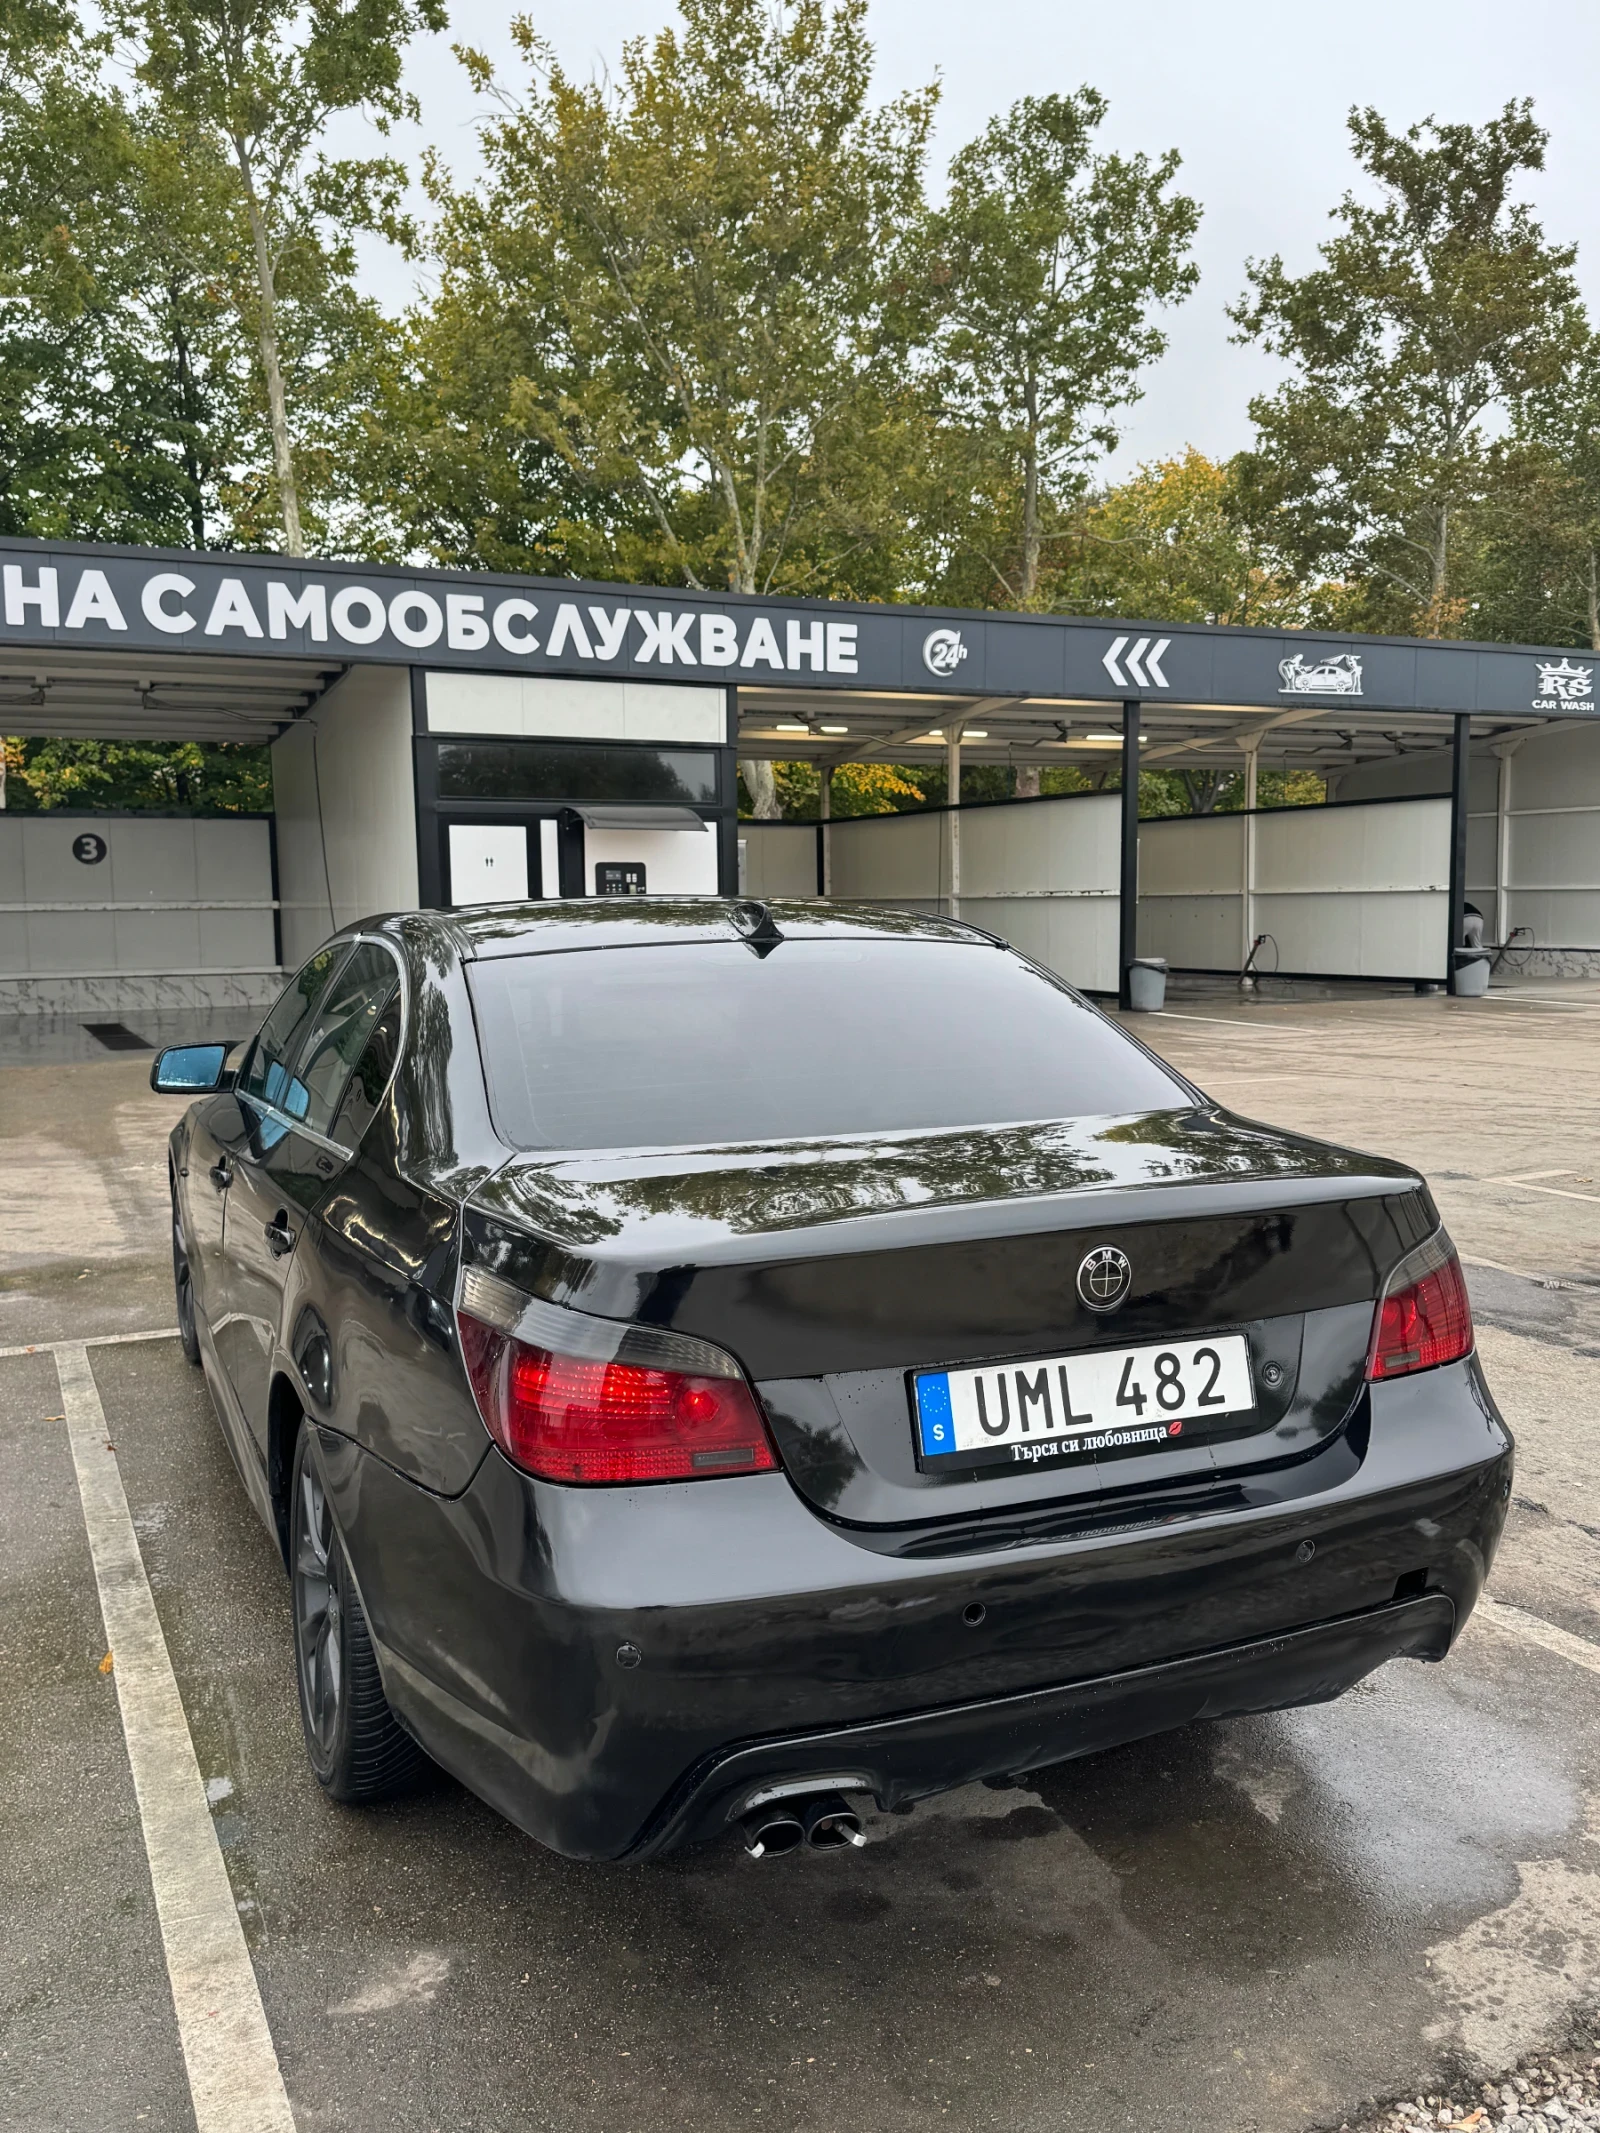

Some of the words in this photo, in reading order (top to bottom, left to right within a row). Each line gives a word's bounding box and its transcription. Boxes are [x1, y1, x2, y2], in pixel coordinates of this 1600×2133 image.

[3, 564, 128, 631] НА
[141, 573, 858, 674] САМООБСЛУЖВАНЕ
[932, 642, 968, 668] 24h
[1538, 675, 1594, 700] RS
[1531, 699, 1557, 709] CAR
[1560, 701, 1595, 711] WASH
[81, 837, 98, 860] 3
[1085, 1250, 1127, 1271] BMW
[974, 1365, 1093, 1436] UML
[1116, 1347, 1226, 1415] 482
[932, 1423, 945, 1441] S
[1011, 1440, 1058, 1462] Търся
[1062, 1439, 1079, 1453] си
[1082, 1426, 1168, 1450] любовница
